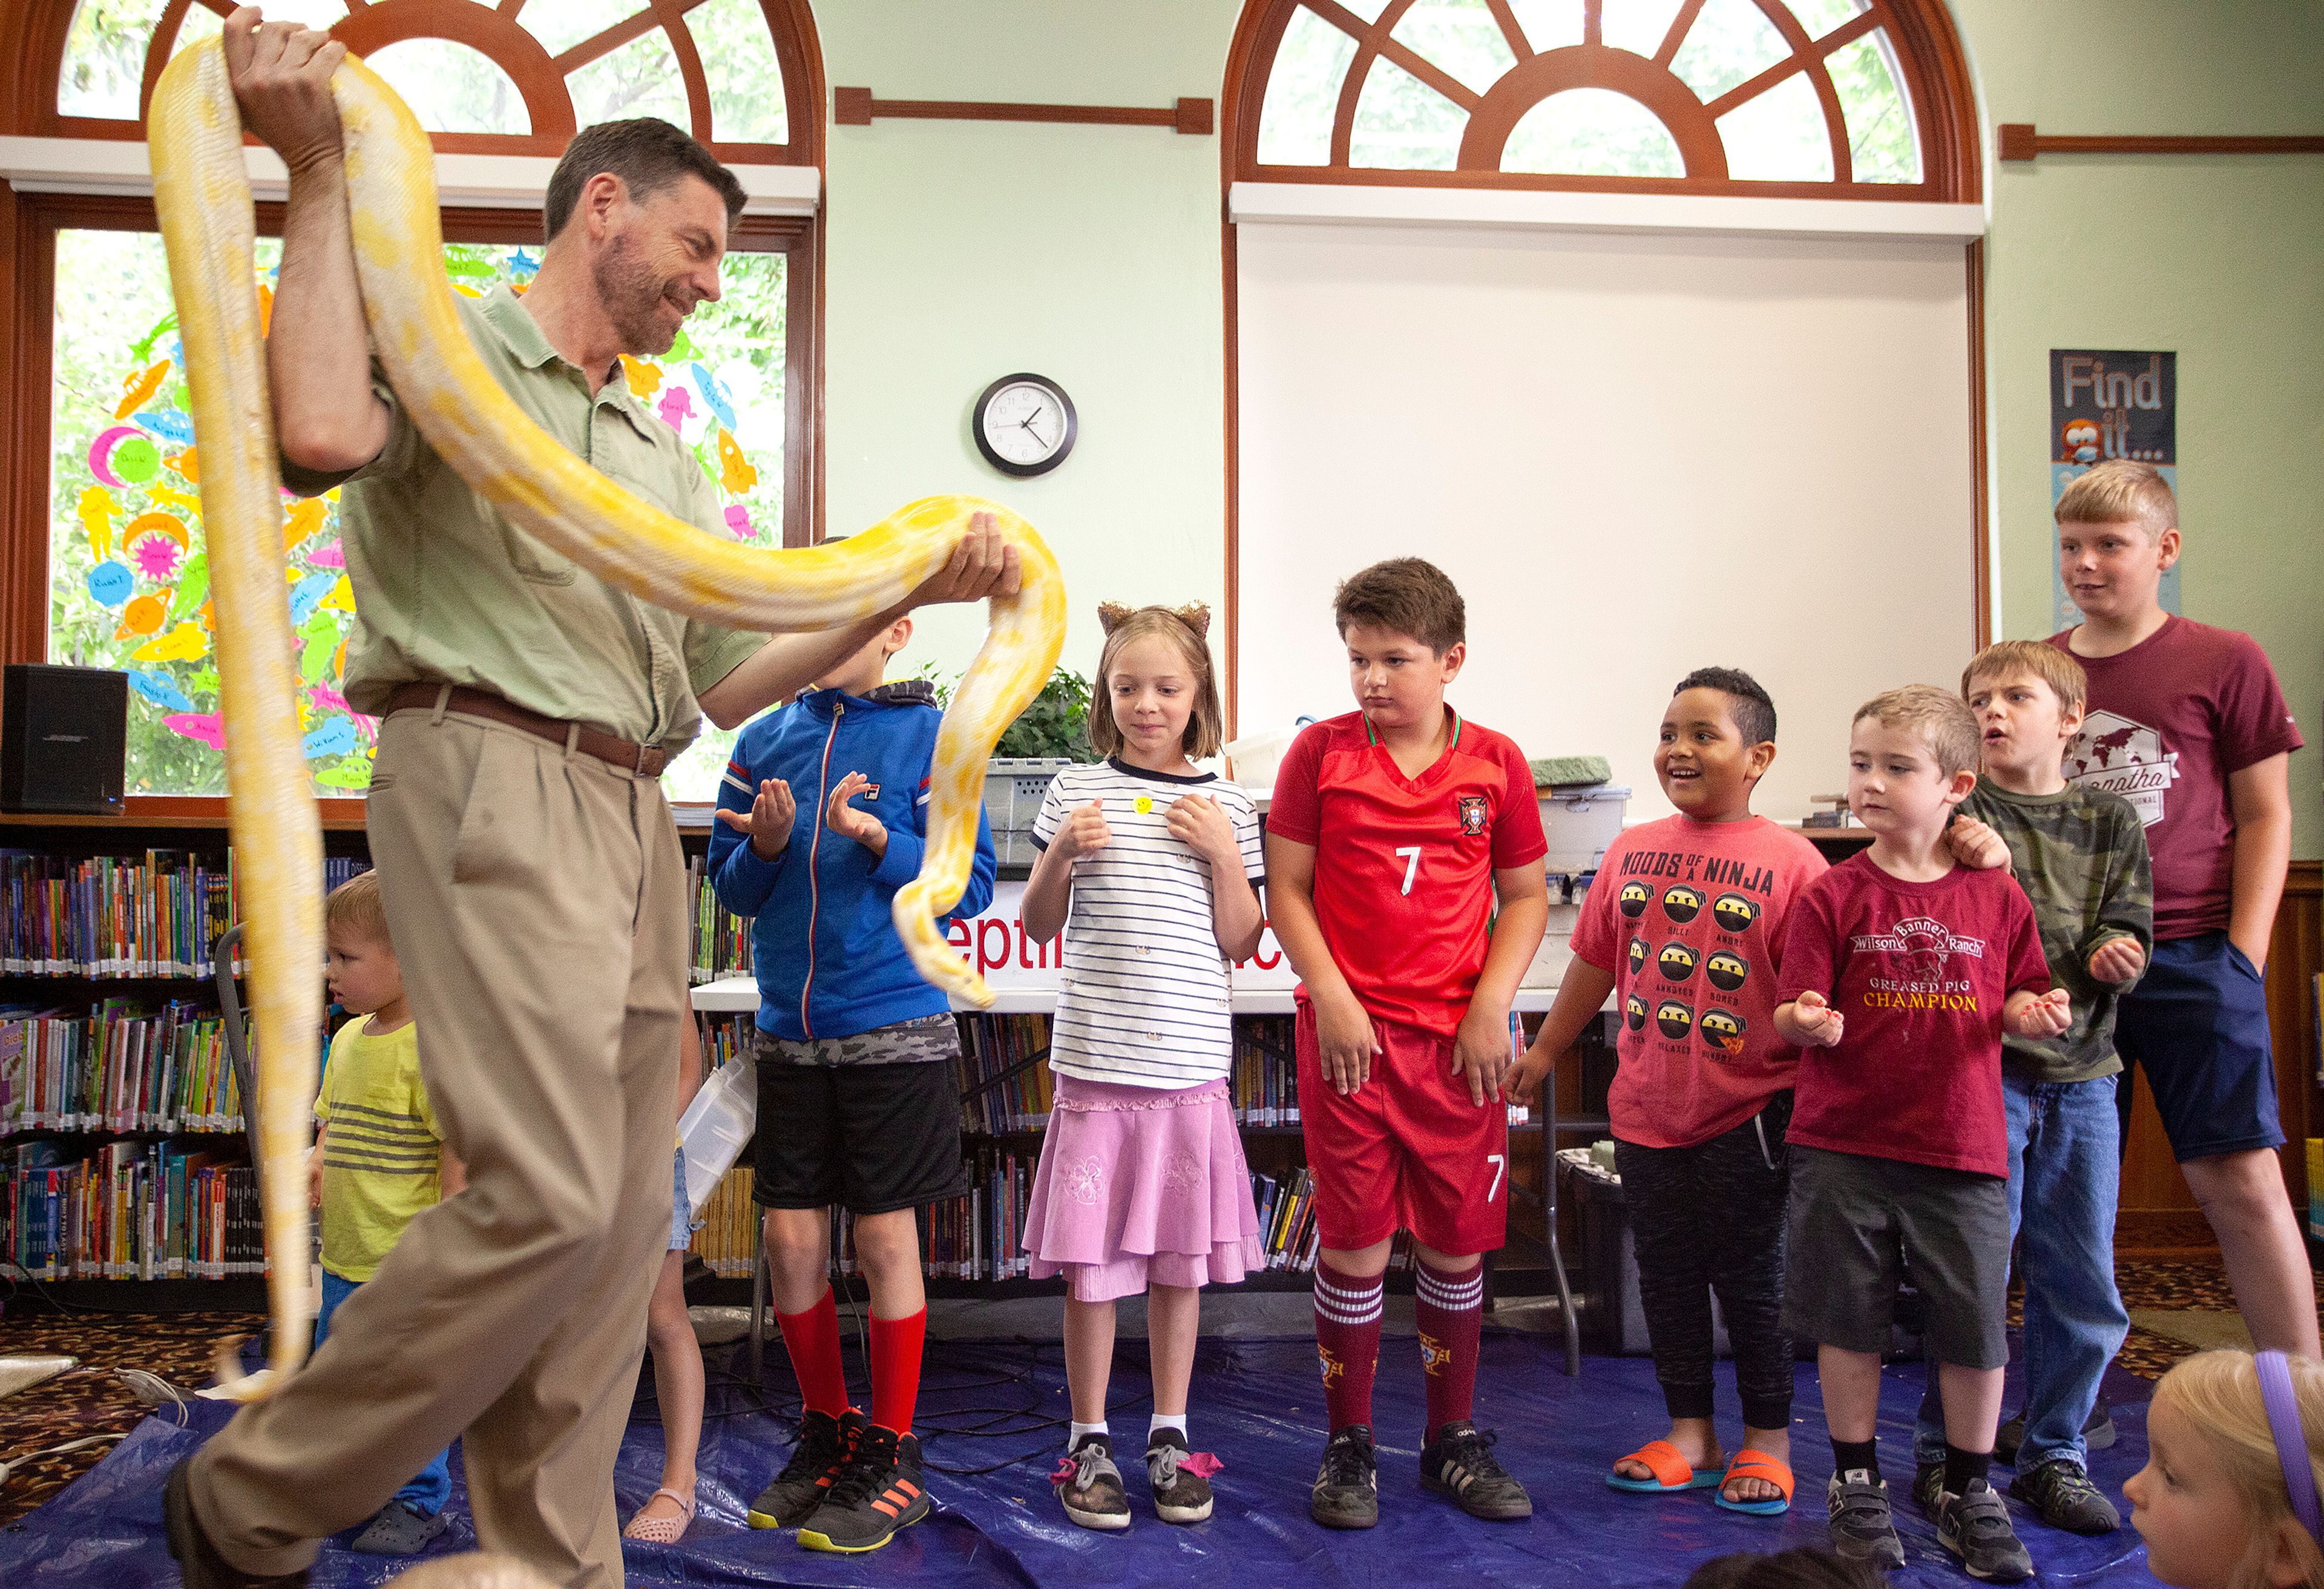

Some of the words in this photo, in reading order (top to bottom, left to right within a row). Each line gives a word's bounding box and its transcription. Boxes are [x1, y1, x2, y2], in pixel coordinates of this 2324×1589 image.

[2063, 354, 2162, 410] Find
[1047, 407, 1052, 416] 2
[1022, 449, 1028, 458] 6
[2092, 768, 2165, 792] natha
[1619, 851, 1682, 878] MOODS
[1686, 854, 1704, 867] OF
[1396, 846, 1422, 896] 7
[1686, 867, 1695, 881] A
[1703, 857, 1774, 897] NINJA
[1896, 920, 1946, 938] Banner
[1856, 936, 1897, 950] Wilson
[1949, 938, 1982, 955] Ranch
[1869, 976, 1940, 993] GREASED
[1945, 979, 1971, 992] PIG
[1863, 992, 1977, 1012] CHAMPION
[1487, 1154, 1505, 1203] 7
